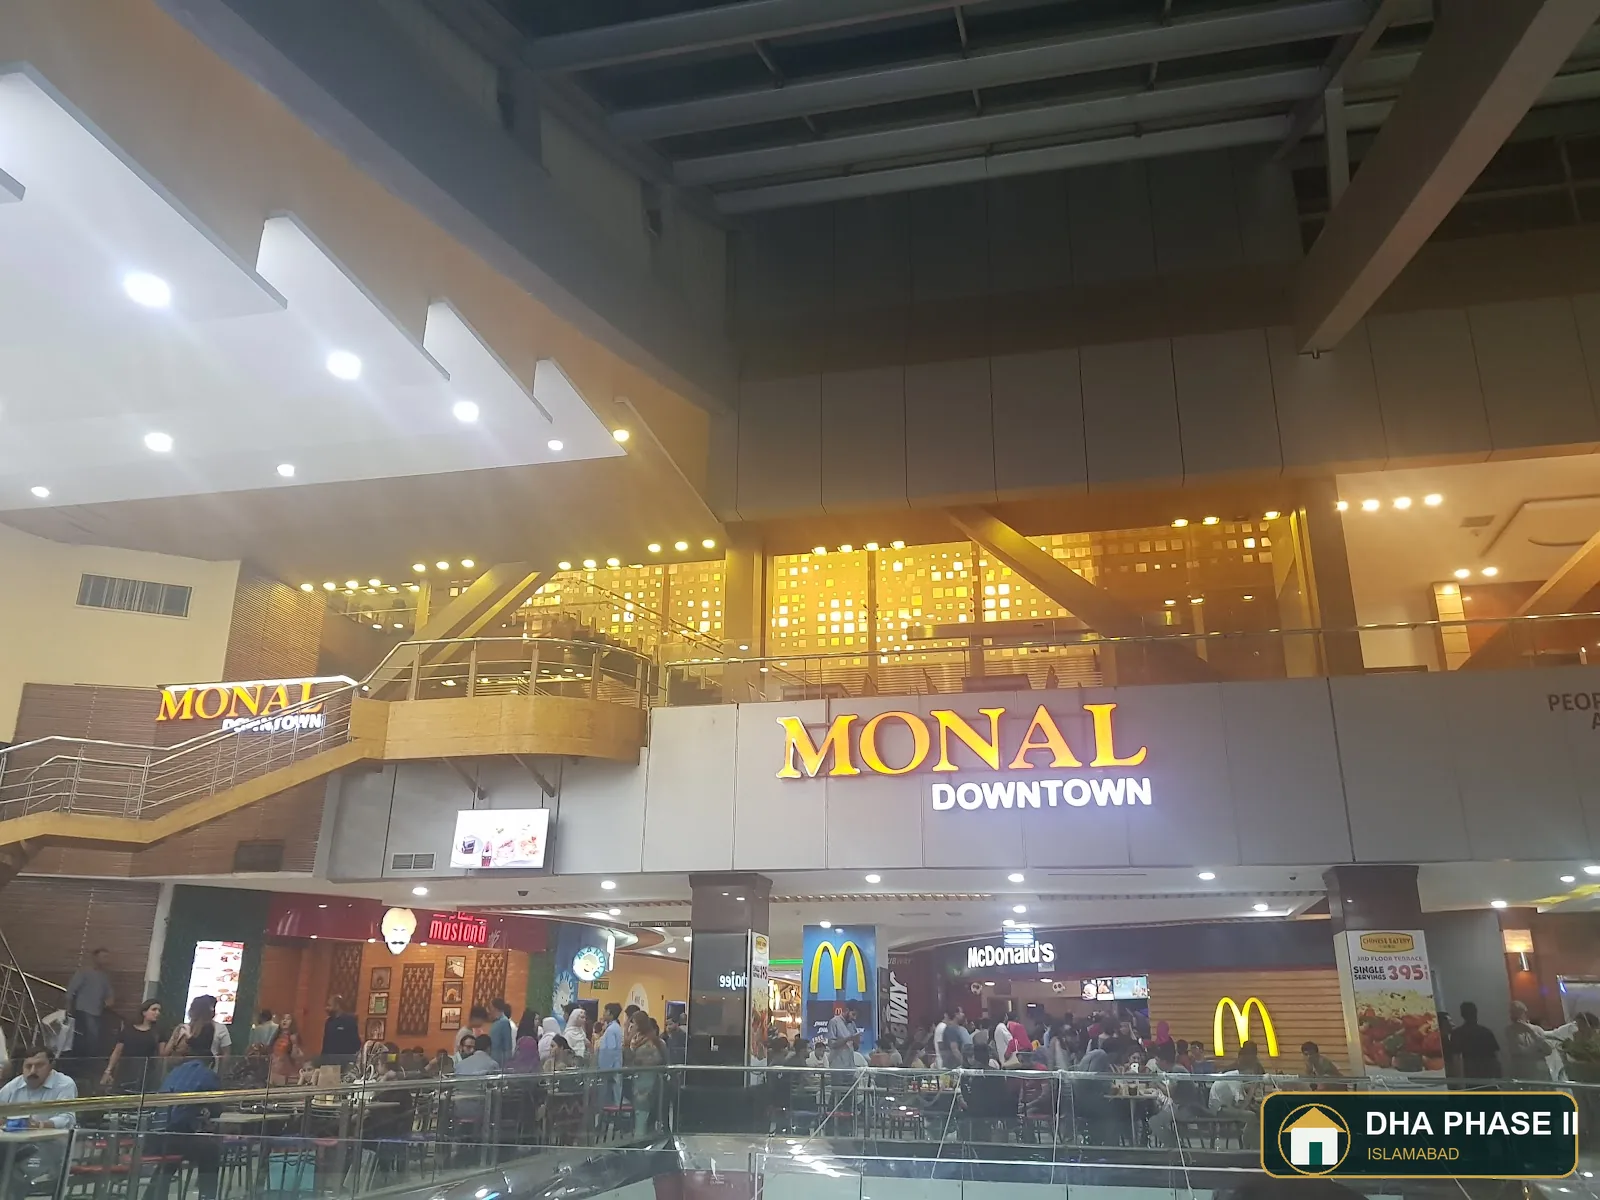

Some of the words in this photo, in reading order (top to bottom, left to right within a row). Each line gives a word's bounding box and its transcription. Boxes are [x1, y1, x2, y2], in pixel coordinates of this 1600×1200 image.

[155, 682, 324, 721] MONAL
[775, 703, 1149, 779] MONAL
[931, 777, 1152, 811] DOWNTOWN
[428, 919, 487, 943] mastana
[576, 946, 606, 979] MANOLO
[967, 940, 1055, 969] McDonald's
[1353, 965, 1385, 974] SINGLE
[1387, 964, 1424, 981] 395
